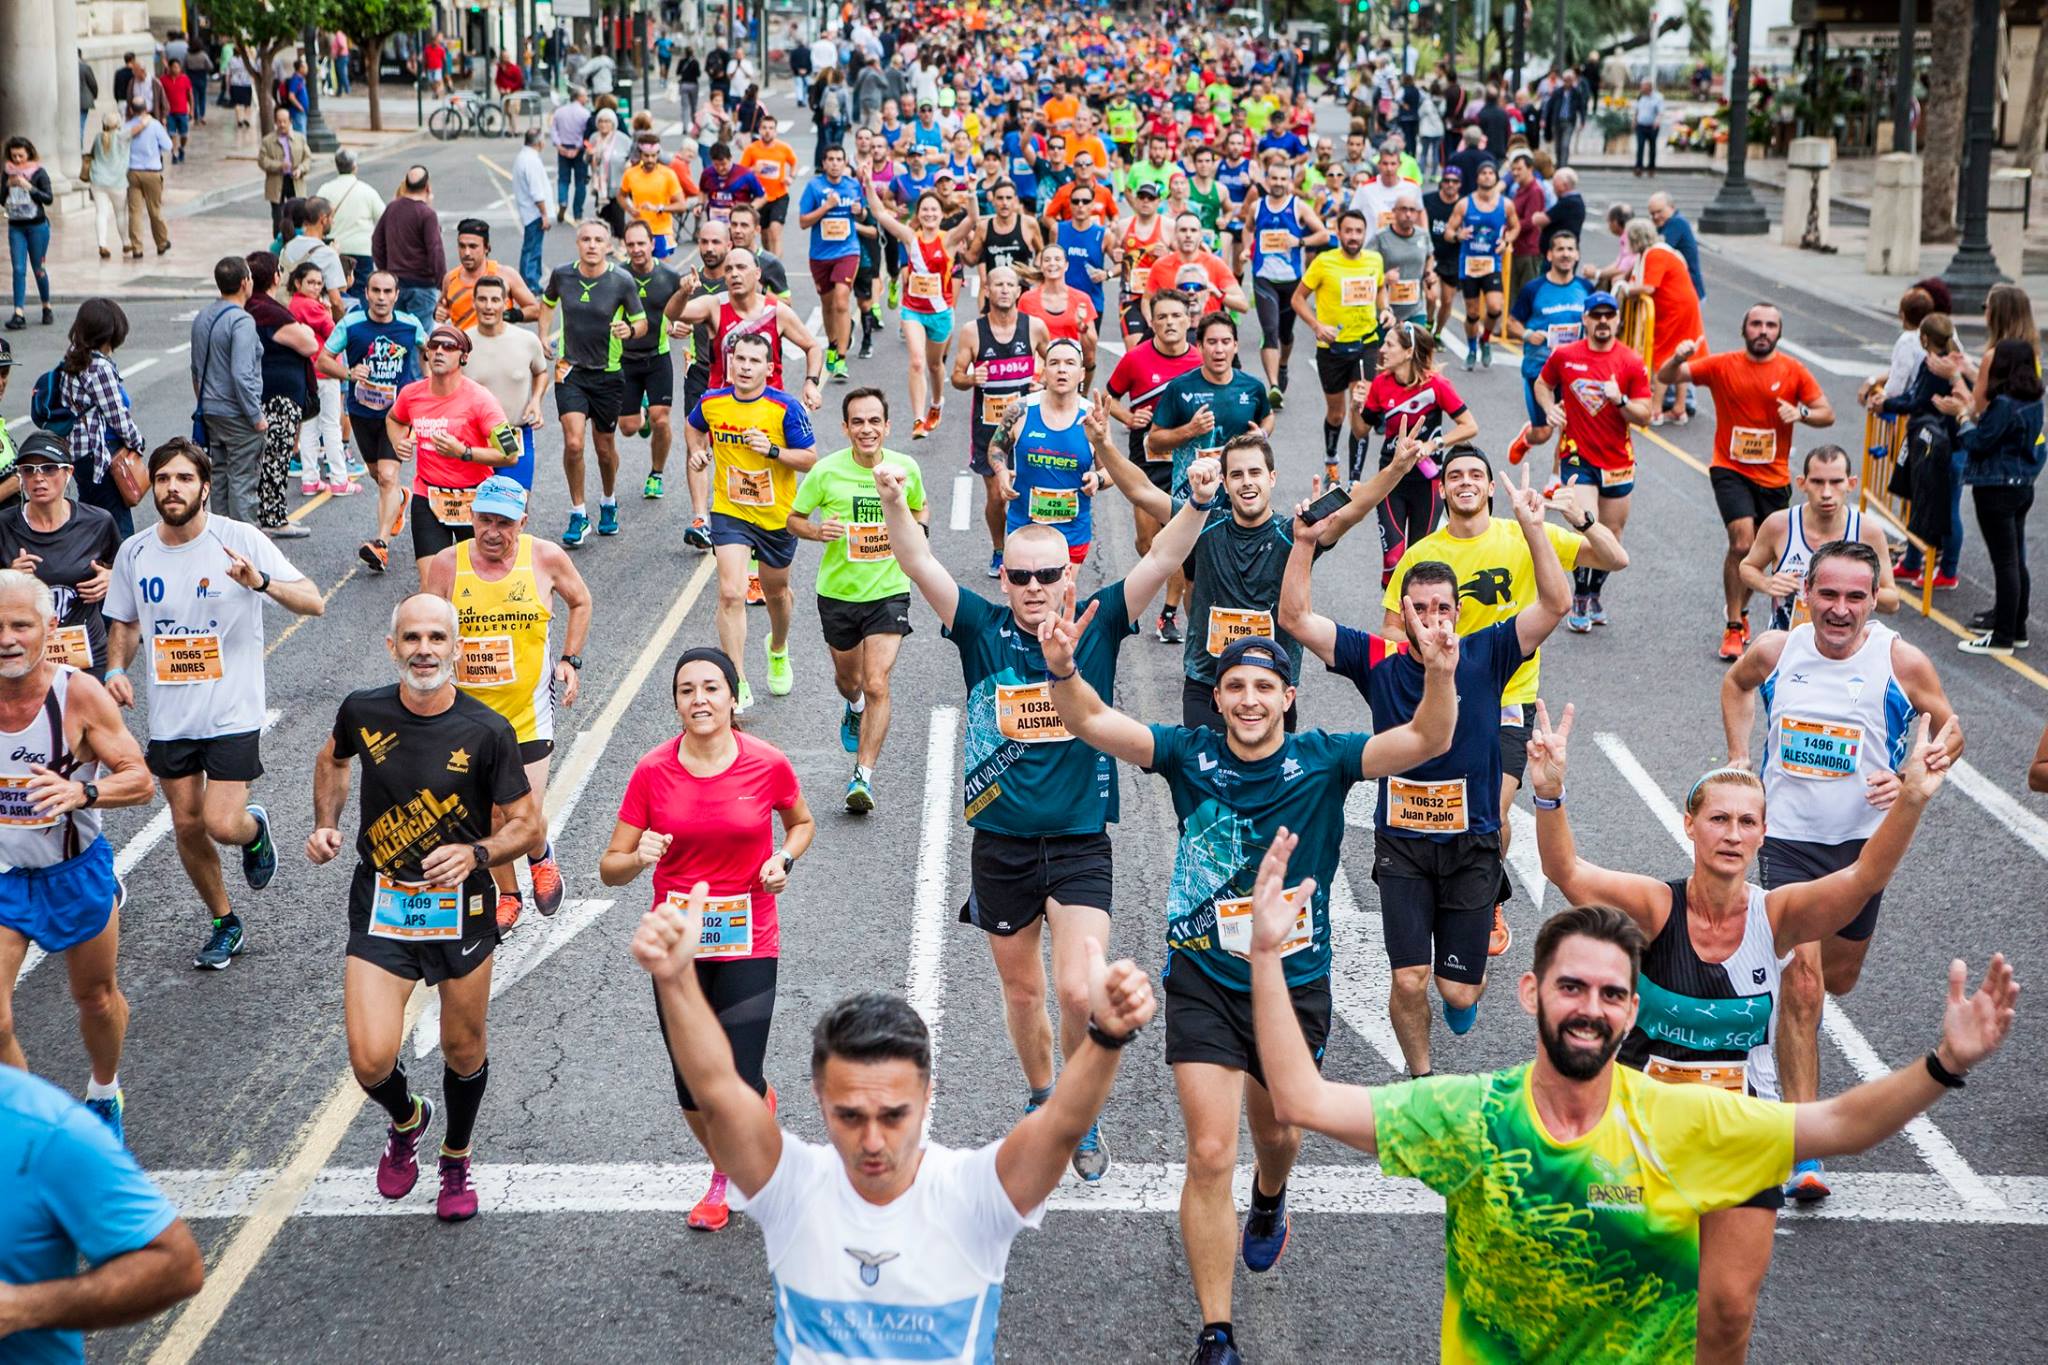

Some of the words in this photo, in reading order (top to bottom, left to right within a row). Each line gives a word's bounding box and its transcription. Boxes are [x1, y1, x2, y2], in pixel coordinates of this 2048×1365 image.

[1027, 453, 1078, 468] runners
[446, 509, 460, 517] JAVI
[1036, 508, 1052, 517] JOSE
[1053, 509, 1072, 517] FELIX
[864, 534, 889, 543] 10543
[139, 576, 165, 604] 10
[458, 612, 539, 625] correcaminos
[466, 622, 532, 633] VALENCIA
[1228, 625, 1252, 636] 1895
[171, 649, 202, 661] 10565
[466, 653, 493, 662] 10198
[170, 662, 206, 674] ANDRES
[466, 665, 498, 676] AGUSTIN
[1017, 717, 1062, 730] ALISTAIR
[1803, 737, 1833, 751] 1496
[1783, 748, 1850, 770] ALESSANDRO
[1410, 796, 1433, 808] 10632
[1400, 808, 1424, 821] Juan
[1426, 810, 1454, 823] Pablo
[370, 808, 408, 846] VUELA
[372, 812, 438, 867] VALENCIA
[402, 897, 432, 909] 1409
[404, 913, 427, 927] APS
[866, 1312, 935, 1333] LAZIO
